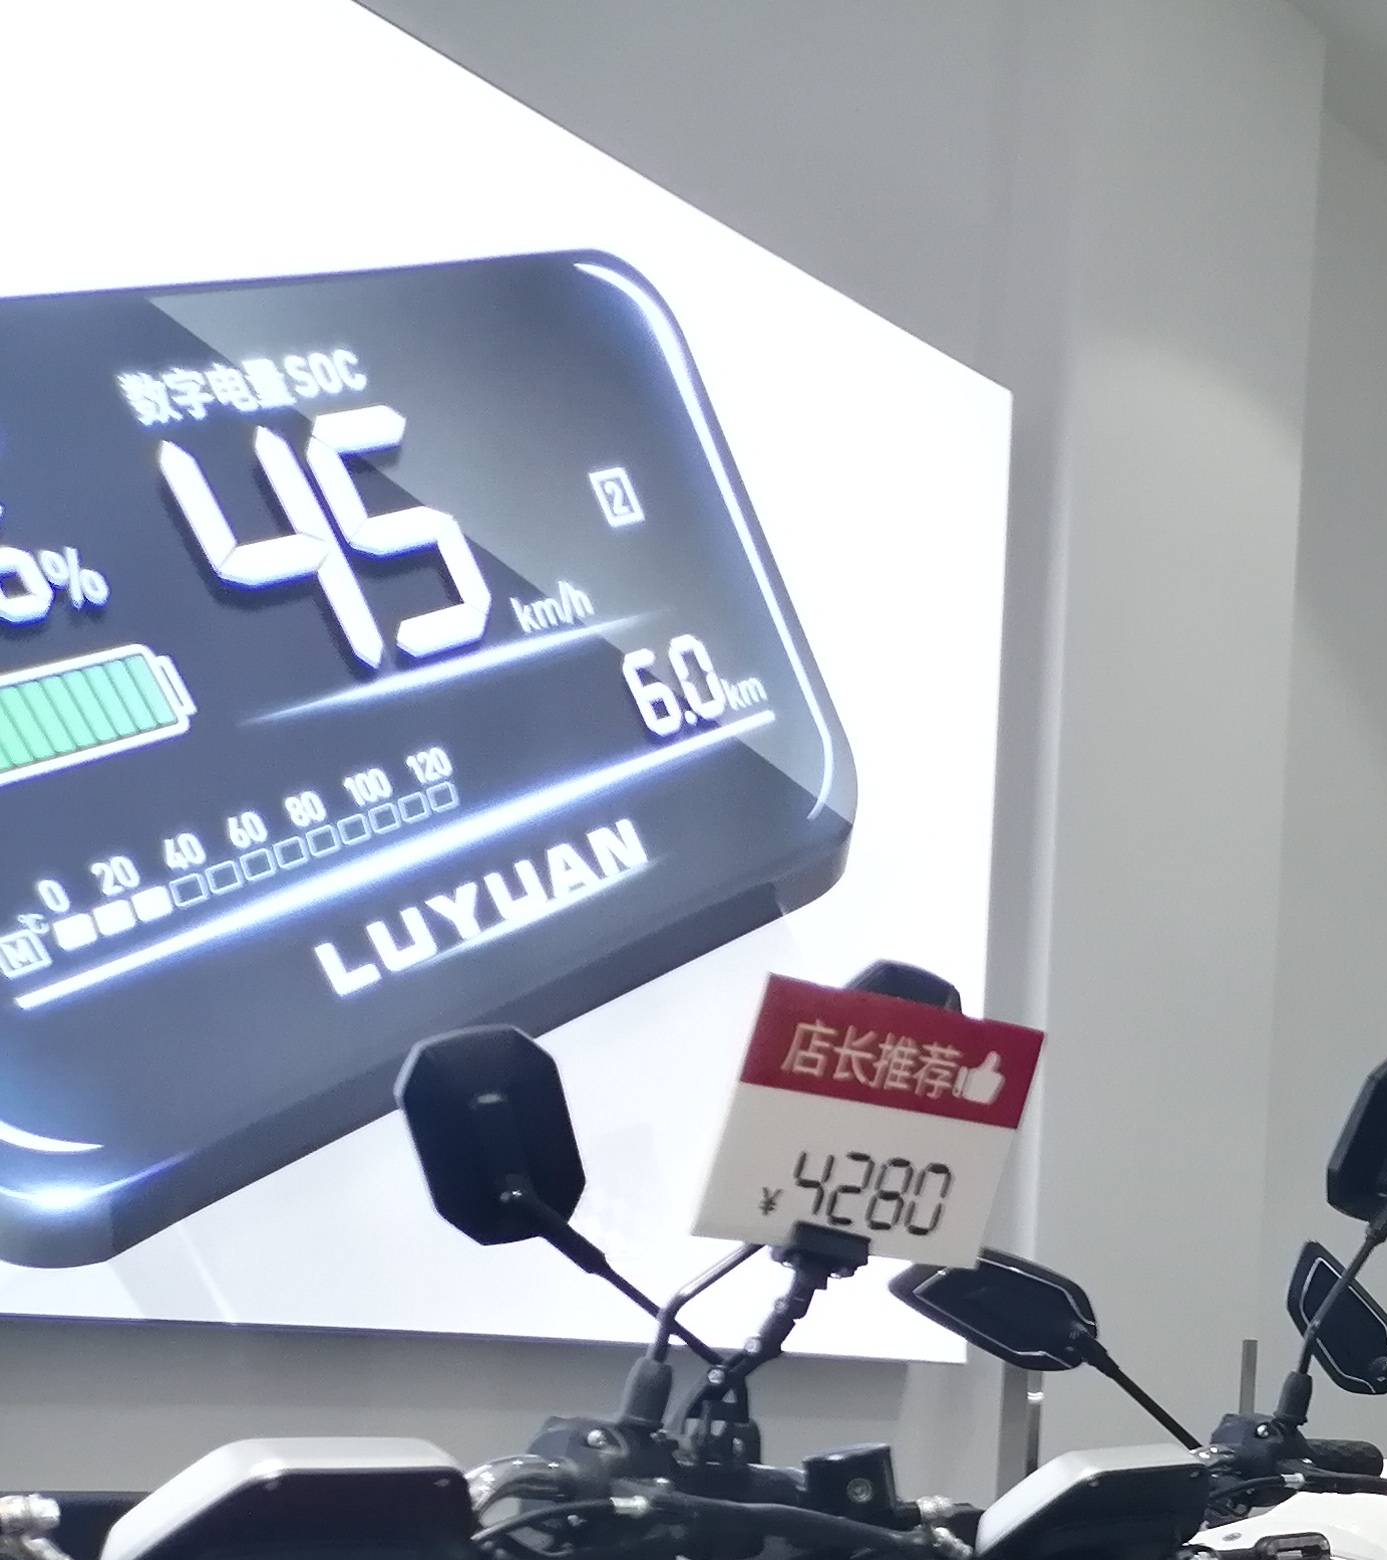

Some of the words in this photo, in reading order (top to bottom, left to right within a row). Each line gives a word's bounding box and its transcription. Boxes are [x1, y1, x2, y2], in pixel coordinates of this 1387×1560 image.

[115, 349, 368, 426] 数字电量SOC
[160, 404, 492, 669] 45
[511, 580, 595, 633] km/h
[37, 879, 71, 914] 0
[91, 855, 141, 897] 20
[162, 832, 208, 871] 40
[226, 810, 270, 849] 60
[283, 790, 328, 828] 80
[343, 768, 394, 807] 100
[406, 746, 455, 785] 120
[314, 818, 648, 998] LUYUAN
[780, 1019, 963, 1100] 店长推荐
